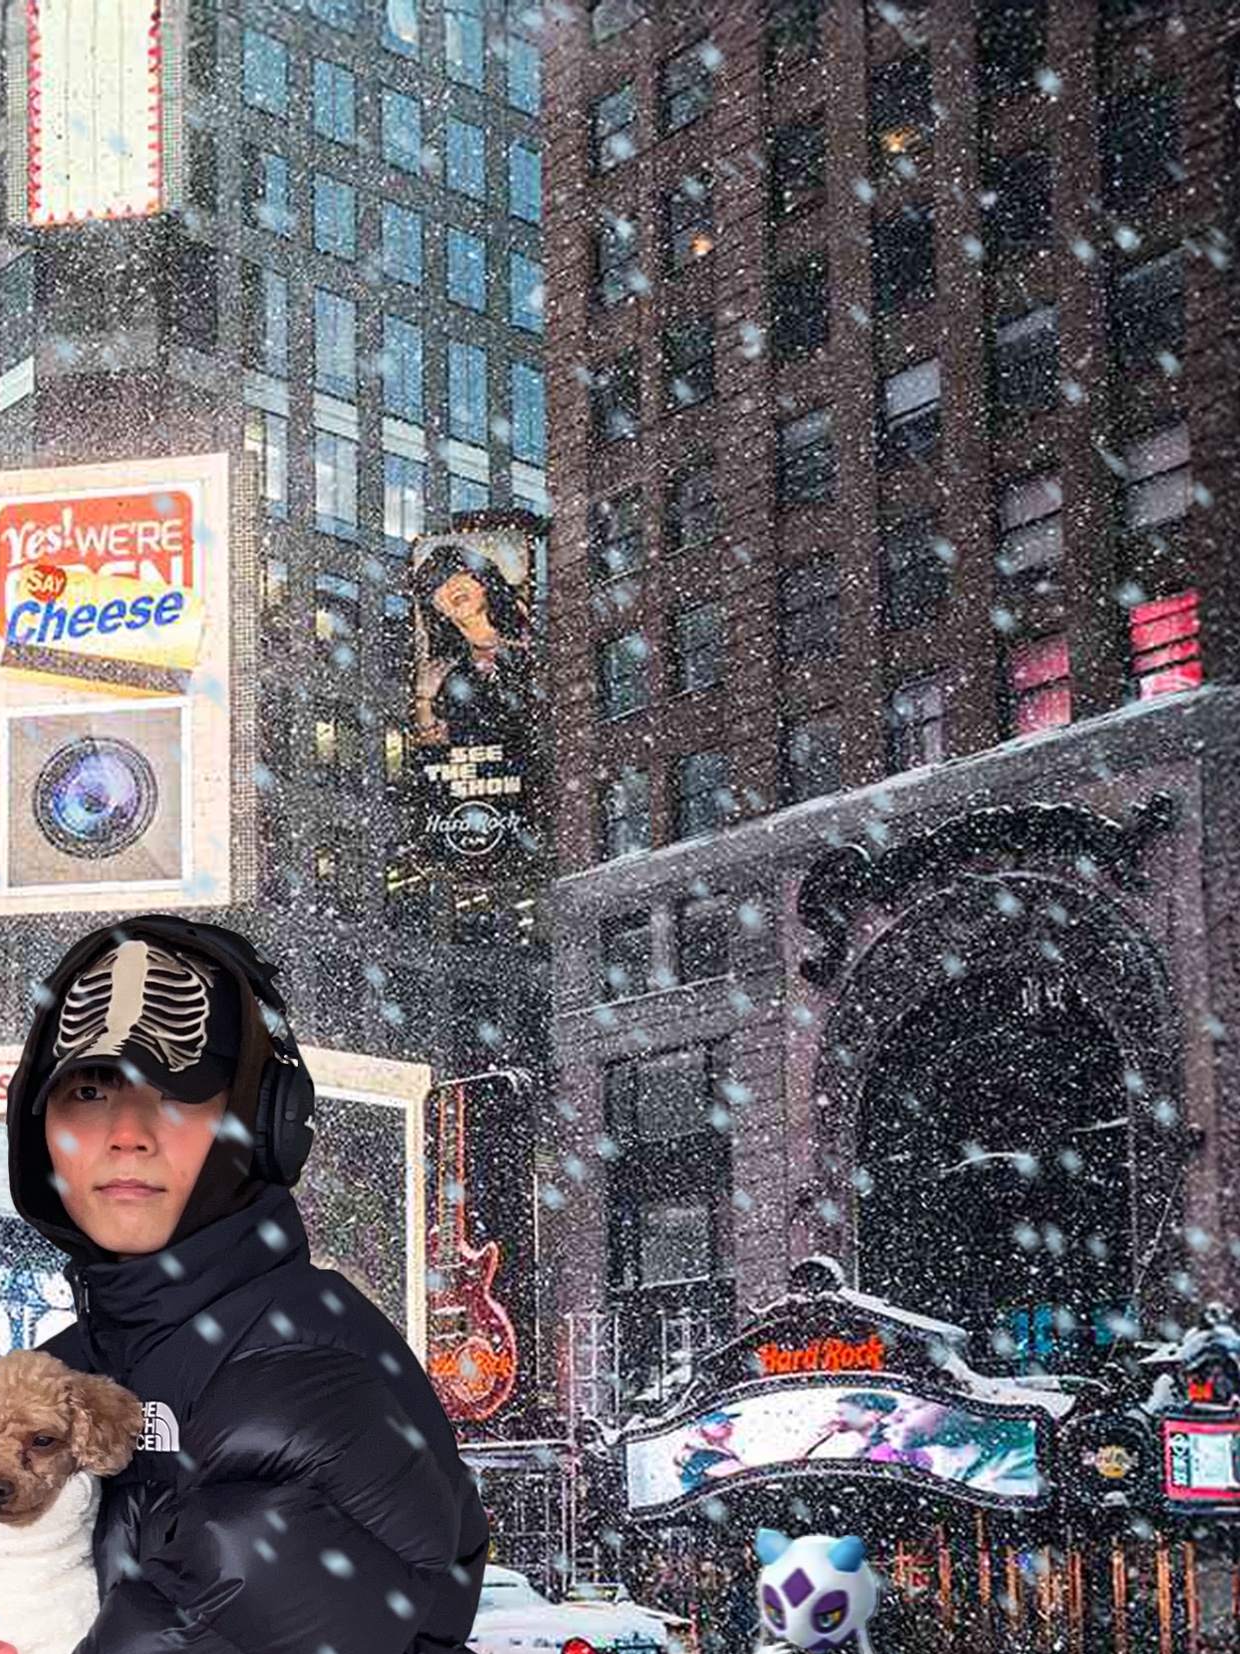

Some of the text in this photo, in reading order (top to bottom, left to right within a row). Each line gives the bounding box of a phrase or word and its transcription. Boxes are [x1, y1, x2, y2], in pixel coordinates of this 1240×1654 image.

[0, 507, 183, 568] Yes! WE'RE
[25, 569, 64, 594] SAY
[5, 590, 184, 648] Cheese
[449, 745, 503, 764] SEE
[424, 763, 477, 782] THE
[450, 776, 521, 799] SHOW
[760, 1334, 885, 1374] Hard Rock
[135, 1433, 156, 1451] CE
